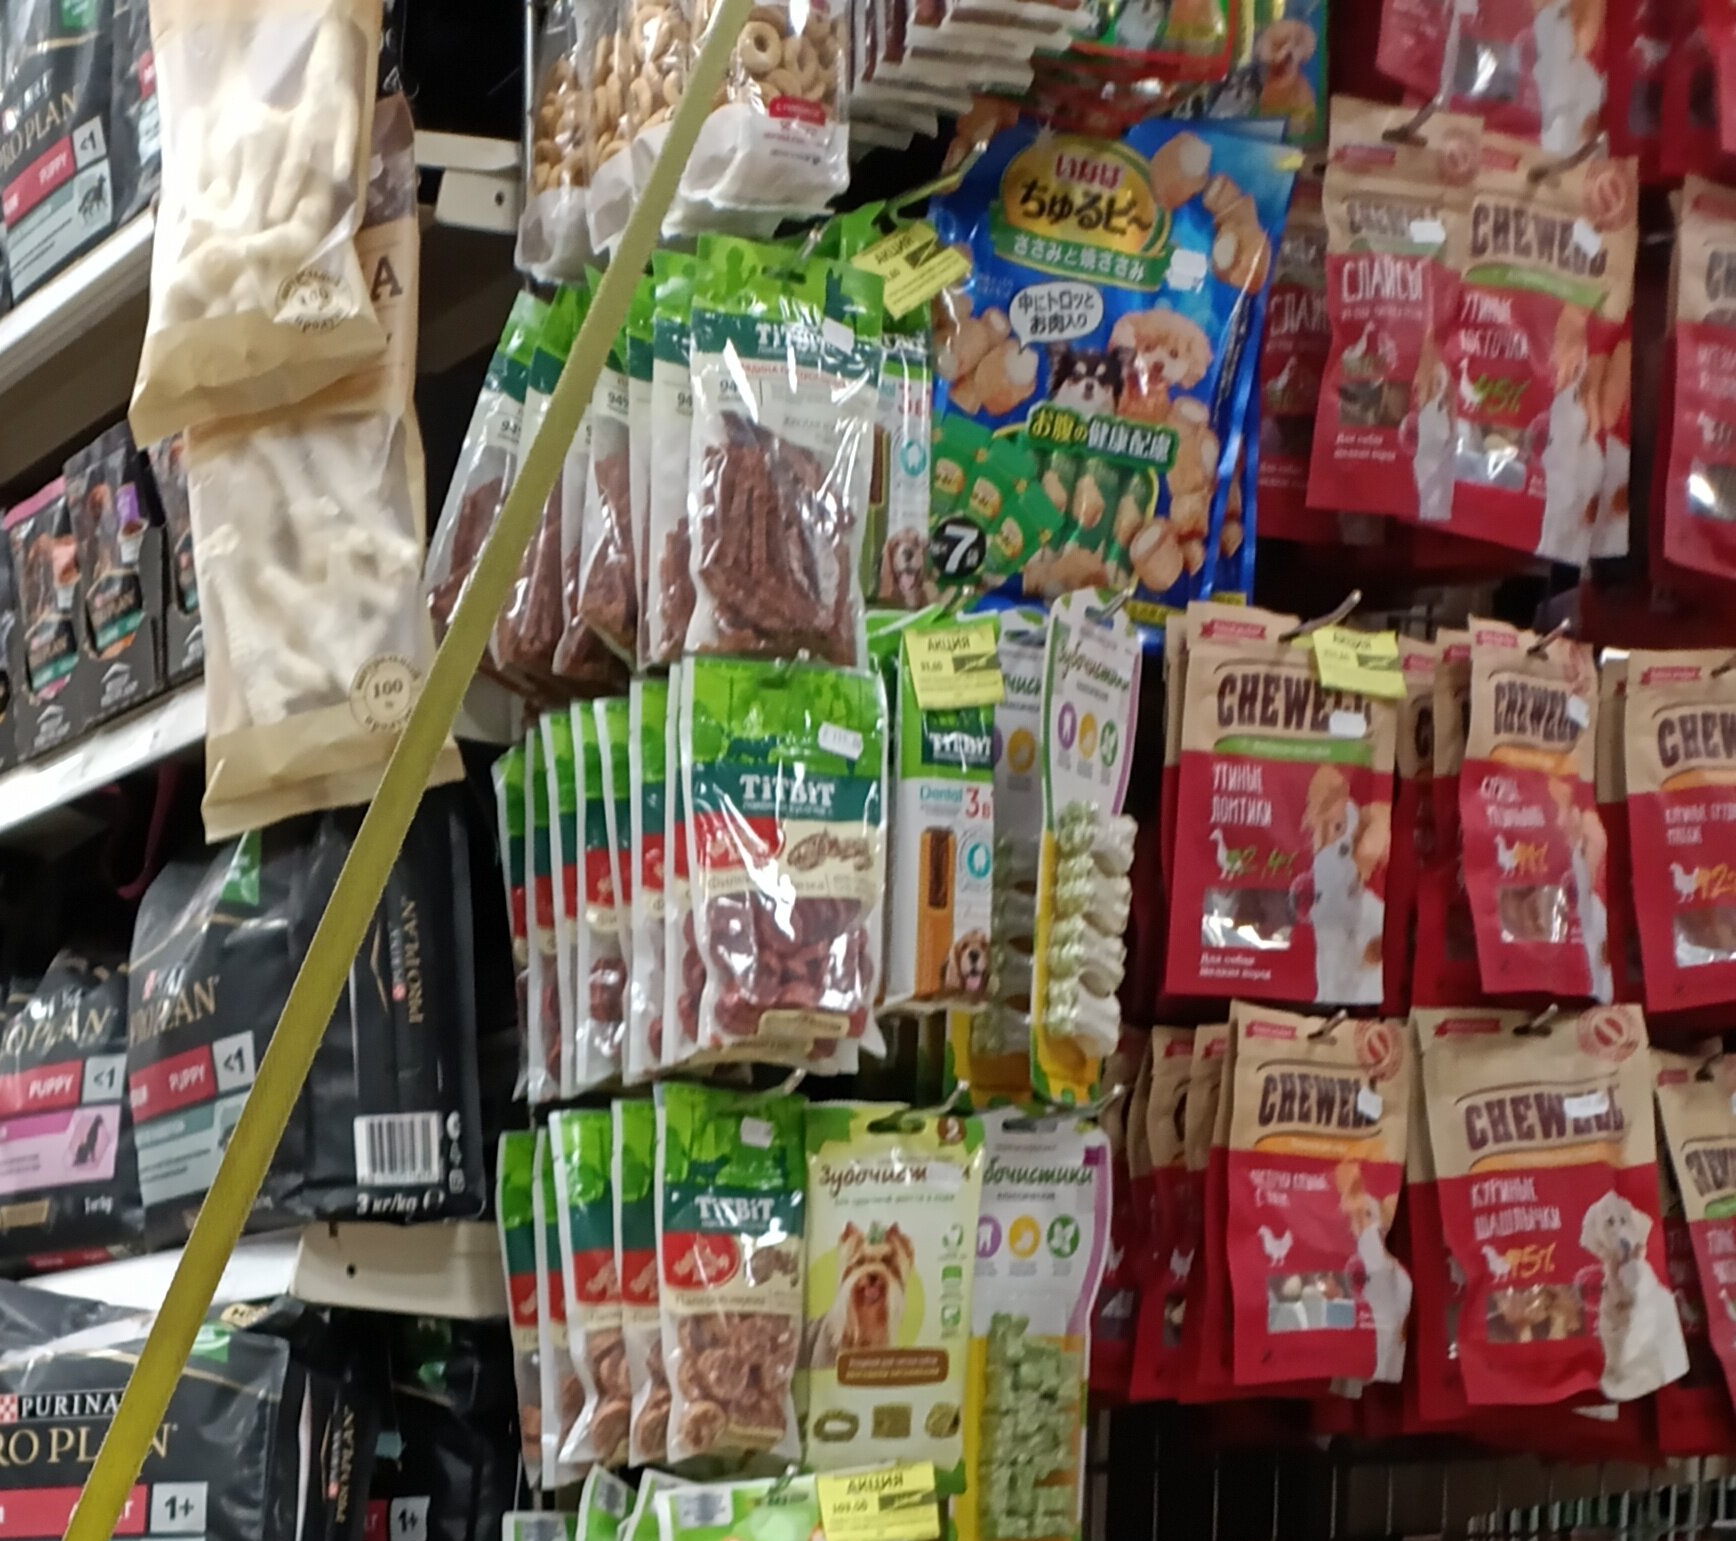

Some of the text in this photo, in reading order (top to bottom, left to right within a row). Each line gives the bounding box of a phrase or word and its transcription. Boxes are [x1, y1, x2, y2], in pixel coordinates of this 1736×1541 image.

[1342, 257, 1425, 303] СЛАЙСЫ
[373, 678, 404, 699] 100
[1657, 711, 1736, 769] CHEW
[1210, 794, 1272, 826] ЛОМТИКИ
[28, 1074, 75, 1099] PUPPY
[169, 1063, 206, 1093] PUPPY
[819, 1162, 971, 1198] Зубочисти
[982, 1162, 1093, 1189] бочистики
[1471, 1177, 1538, 1209] КУРИНЫЕ
[1474, 1205, 1562, 1242] ШАШЛЫЧКИ
[21, 1391, 121, 1419] PURINA
[47, 1422, 171, 1465] PLN
[846, 1472, 905, 1496] АКЦИЯ
[164, 1496, 195, 1522] 1+
